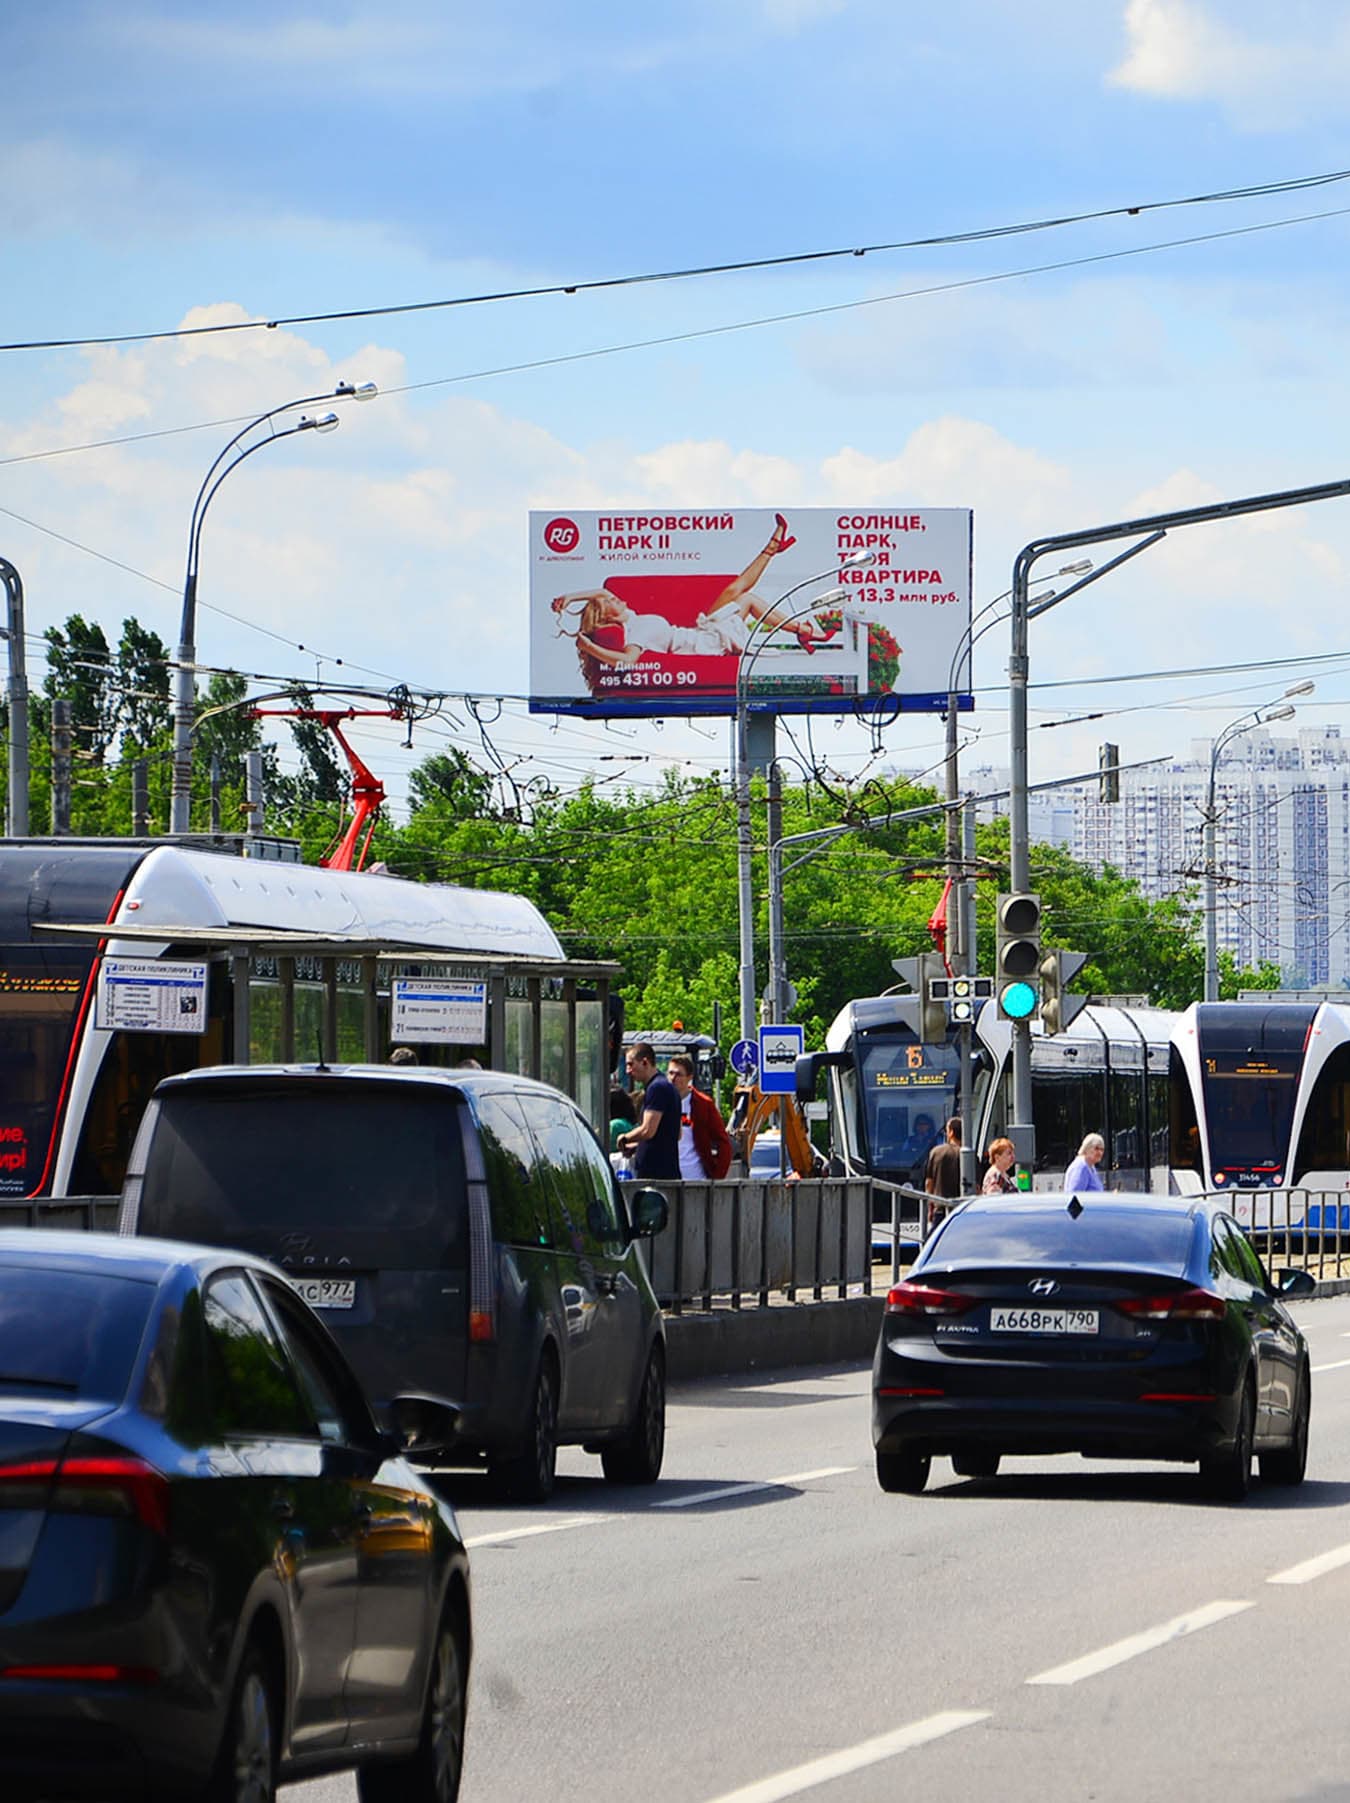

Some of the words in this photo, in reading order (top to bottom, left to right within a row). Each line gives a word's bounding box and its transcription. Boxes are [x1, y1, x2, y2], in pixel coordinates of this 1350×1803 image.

[599, 513, 734, 531] ПЕТРОВСКИЙ
[837, 515, 926, 532] СОЛНЦЕ,
[599, 535, 653, 550] ПАРК
[659, 534, 670, 549] II
[837, 534, 897, 550] ПАРК,
[600, 552, 639, 561] ЖИЛОЙ
[642, 552, 701, 561] КОМПЛЕКС
[837, 552, 890, 566] ТЯ
[838, 570, 942, 584] КВАРТИРА
[857, 588, 895, 603] 13,3
[900, 594, 927, 602] млн
[931, 592, 960, 604] руб.
[600, 663, 612, 671] м.
[615, 661, 661, 671] Динамо
[600, 676, 621, 686] 495
[623, 673, 649, 685] 431
[652, 672, 673, 685] 00
[676, 671, 697, 684] 90
[321, 1281, 350, 1296] 977
[996, 1311, 1064, 1330] А668РК
[1068, 1311, 1095, 1326] 790
